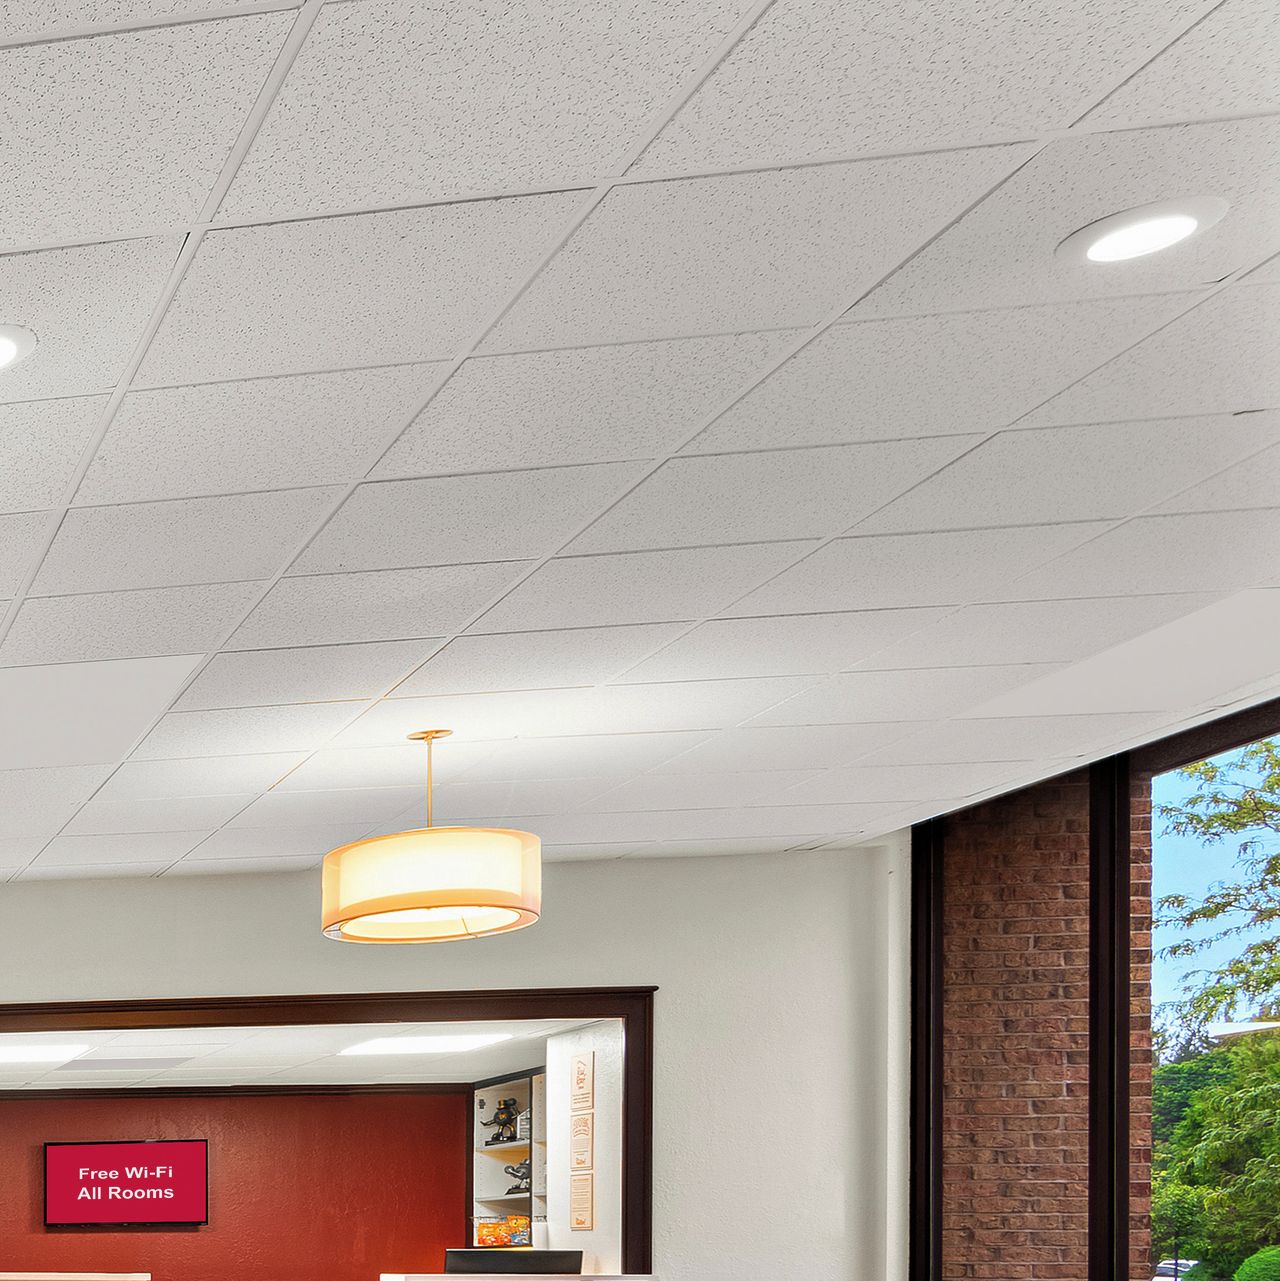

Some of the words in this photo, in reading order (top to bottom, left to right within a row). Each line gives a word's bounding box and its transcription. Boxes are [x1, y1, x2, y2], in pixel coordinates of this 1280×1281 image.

[79, 1167, 119, 1180] Free
[125, 1166, 173, 1179] Wi-Fi
[77, 1186, 102, 1200] All
[108, 1186, 174, 1200] Rooms
